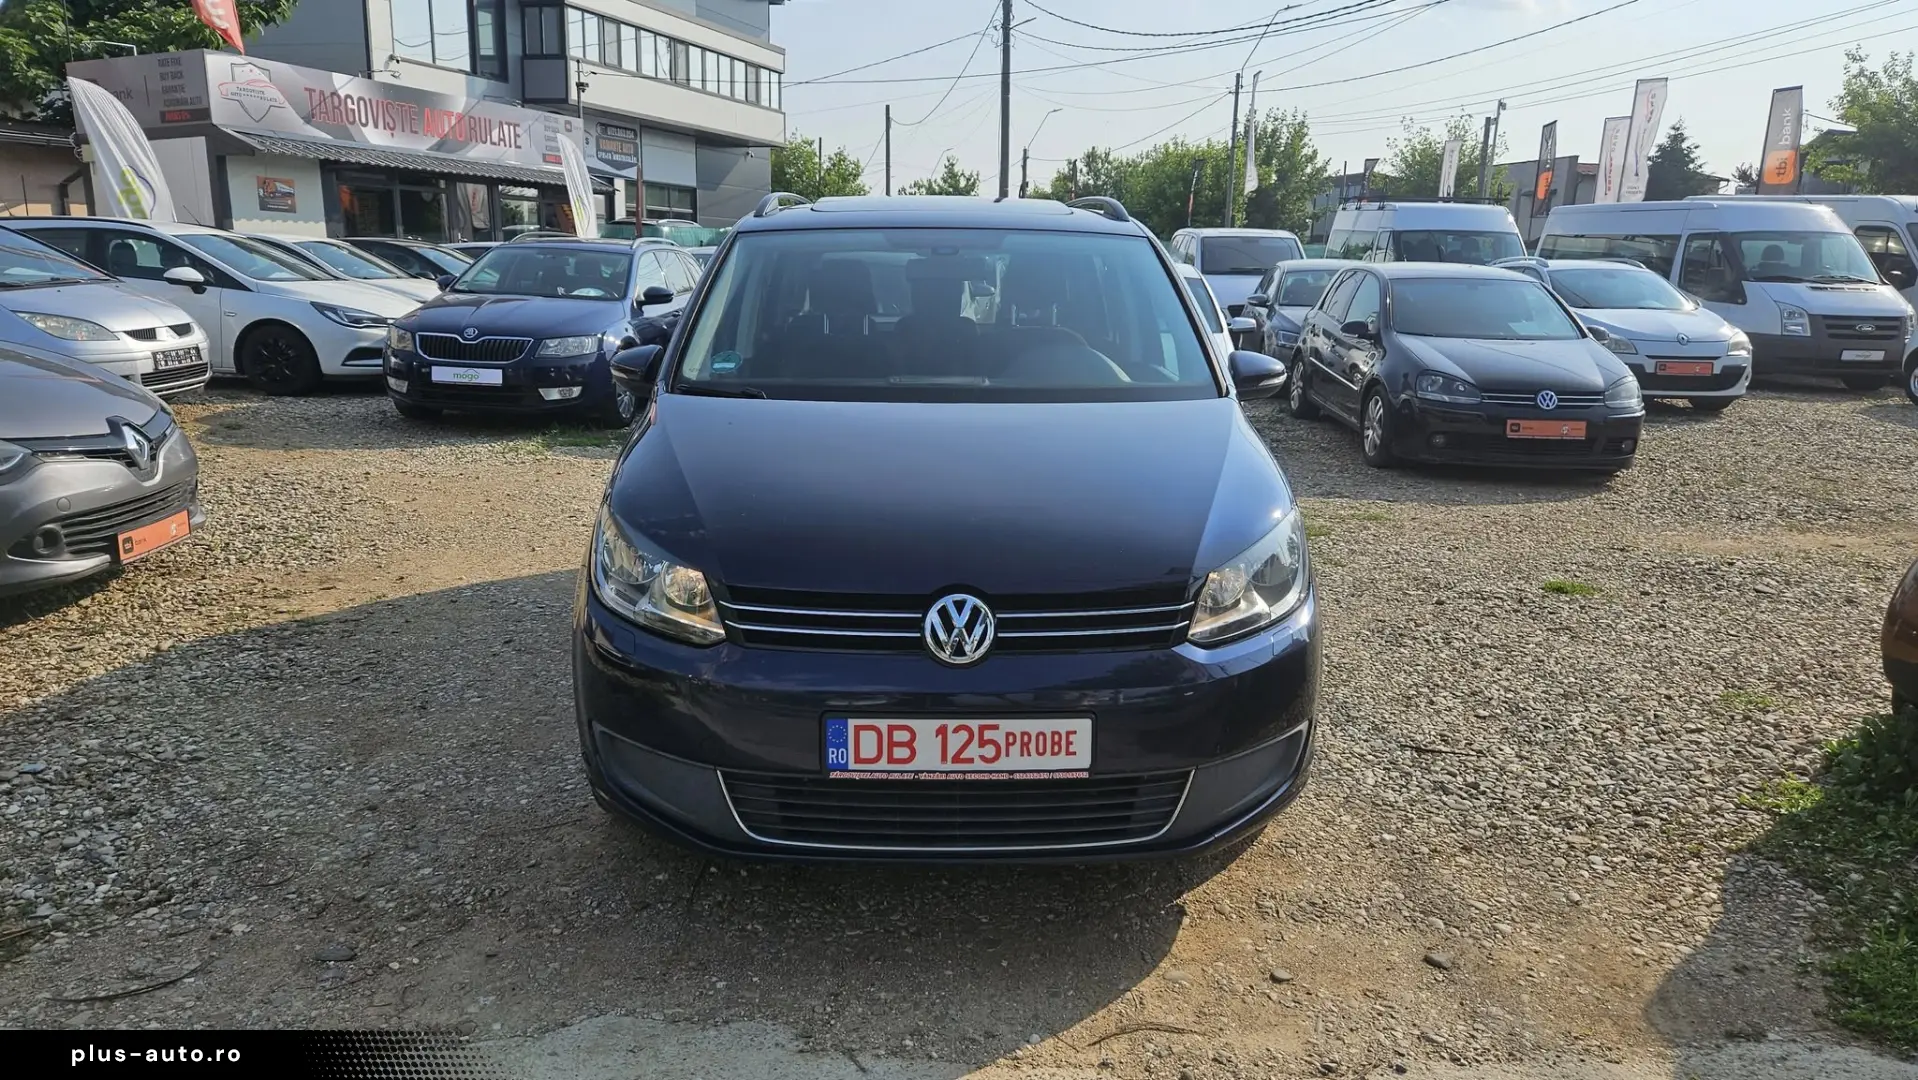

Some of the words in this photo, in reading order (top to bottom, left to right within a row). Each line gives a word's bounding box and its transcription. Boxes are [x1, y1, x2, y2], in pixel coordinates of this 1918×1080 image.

[423, 107, 466, 142] AUTO
[469, 116, 522, 150] RULATE
[1778, 107, 1792, 145] bank
[453, 373, 479, 381] mogo
[829, 748, 847, 763] RO
[853, 724, 917, 765] DB
[935, 723, 1002, 765] 125
[1005, 730, 1077, 757] PROBE
